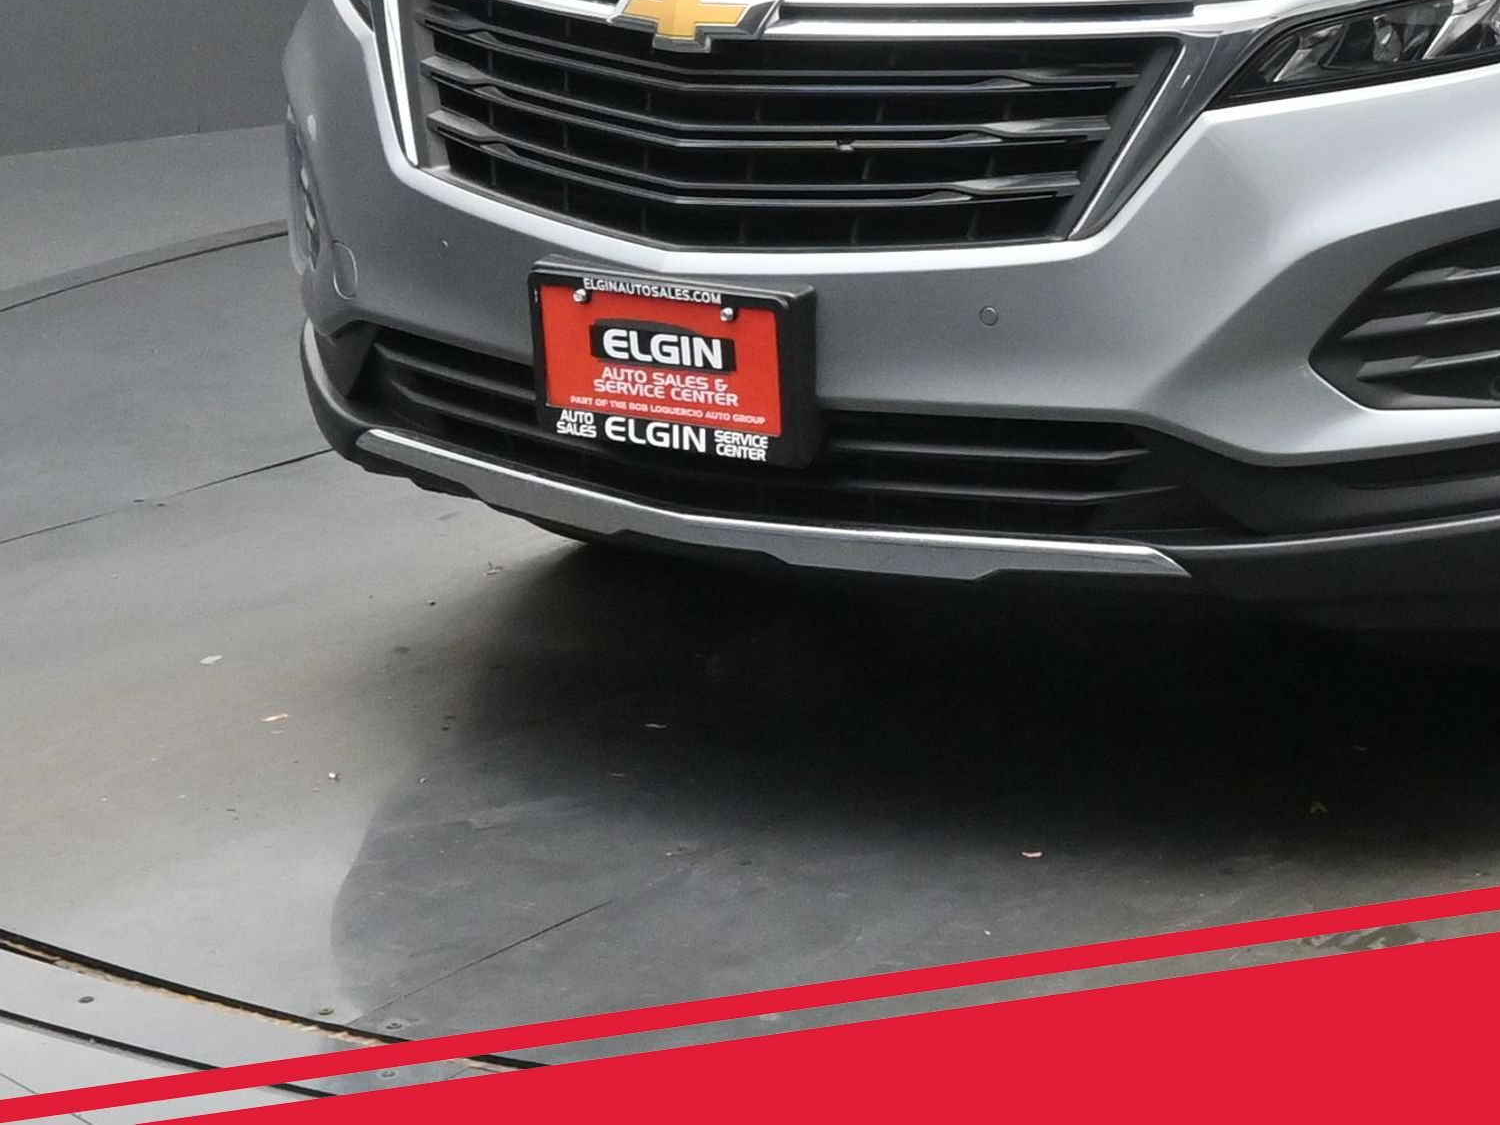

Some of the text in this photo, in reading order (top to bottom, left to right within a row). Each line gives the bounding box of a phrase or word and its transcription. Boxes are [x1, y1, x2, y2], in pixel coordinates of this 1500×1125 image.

[582, 277, 722, 305] ELGINAUTOSALES.COM
[602, 328, 723, 370] ELGIN
[602, 366, 729, 392] AUTO SALES &
[593, 378, 739, 407] SERVICE CENTER
[560, 408, 594, 425] AUTO
[570, 395, 593, 405] PART
[704, 410, 731, 421] AUTO
[556, 421, 597, 438] SALES
[604, 416, 706, 453] ELGIN
[714, 430, 768, 449] SERVICE
[716, 443, 767, 462] CENTER
